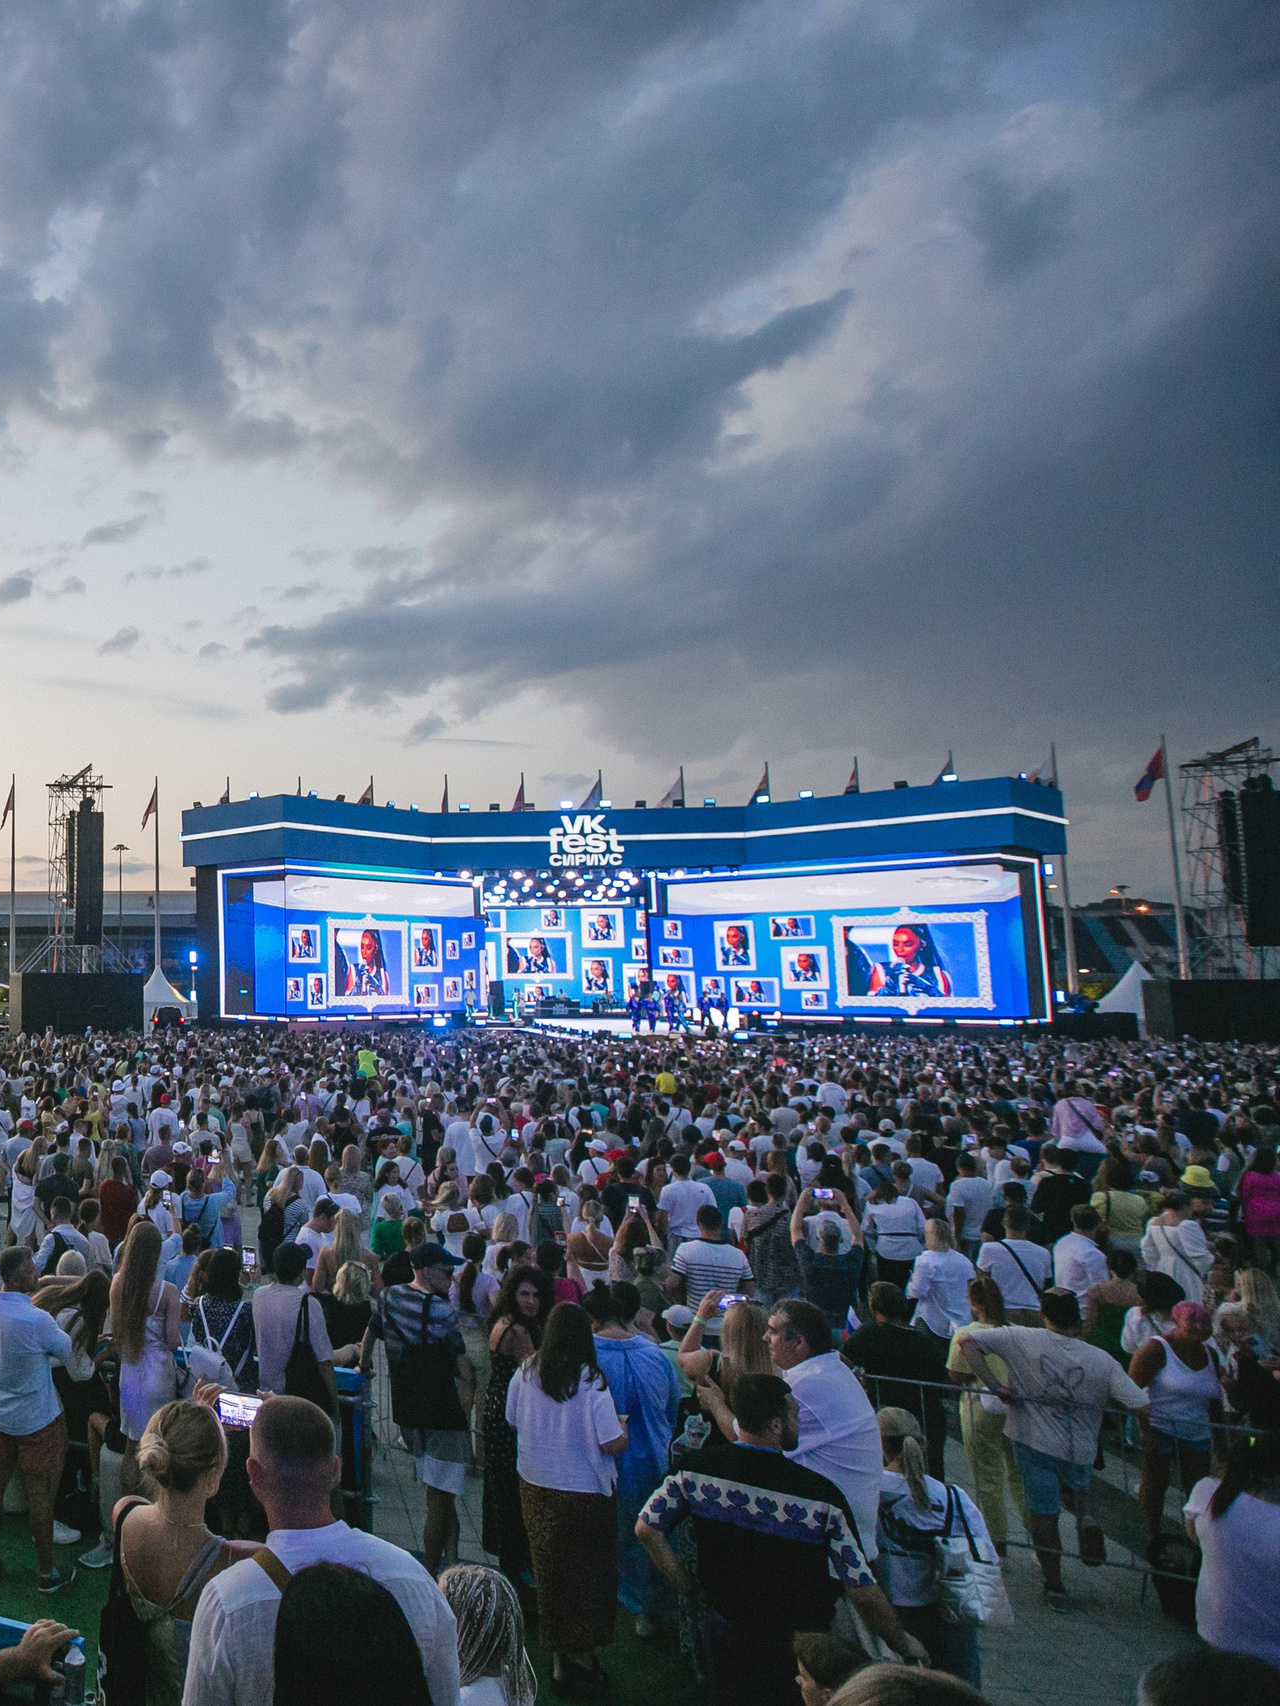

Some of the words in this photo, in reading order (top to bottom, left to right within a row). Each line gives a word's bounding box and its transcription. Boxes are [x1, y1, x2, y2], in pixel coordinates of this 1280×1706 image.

[560, 814, 607, 833] VK
[549, 827, 625, 853] fest
[549, 853, 623, 866] СИРИУС
